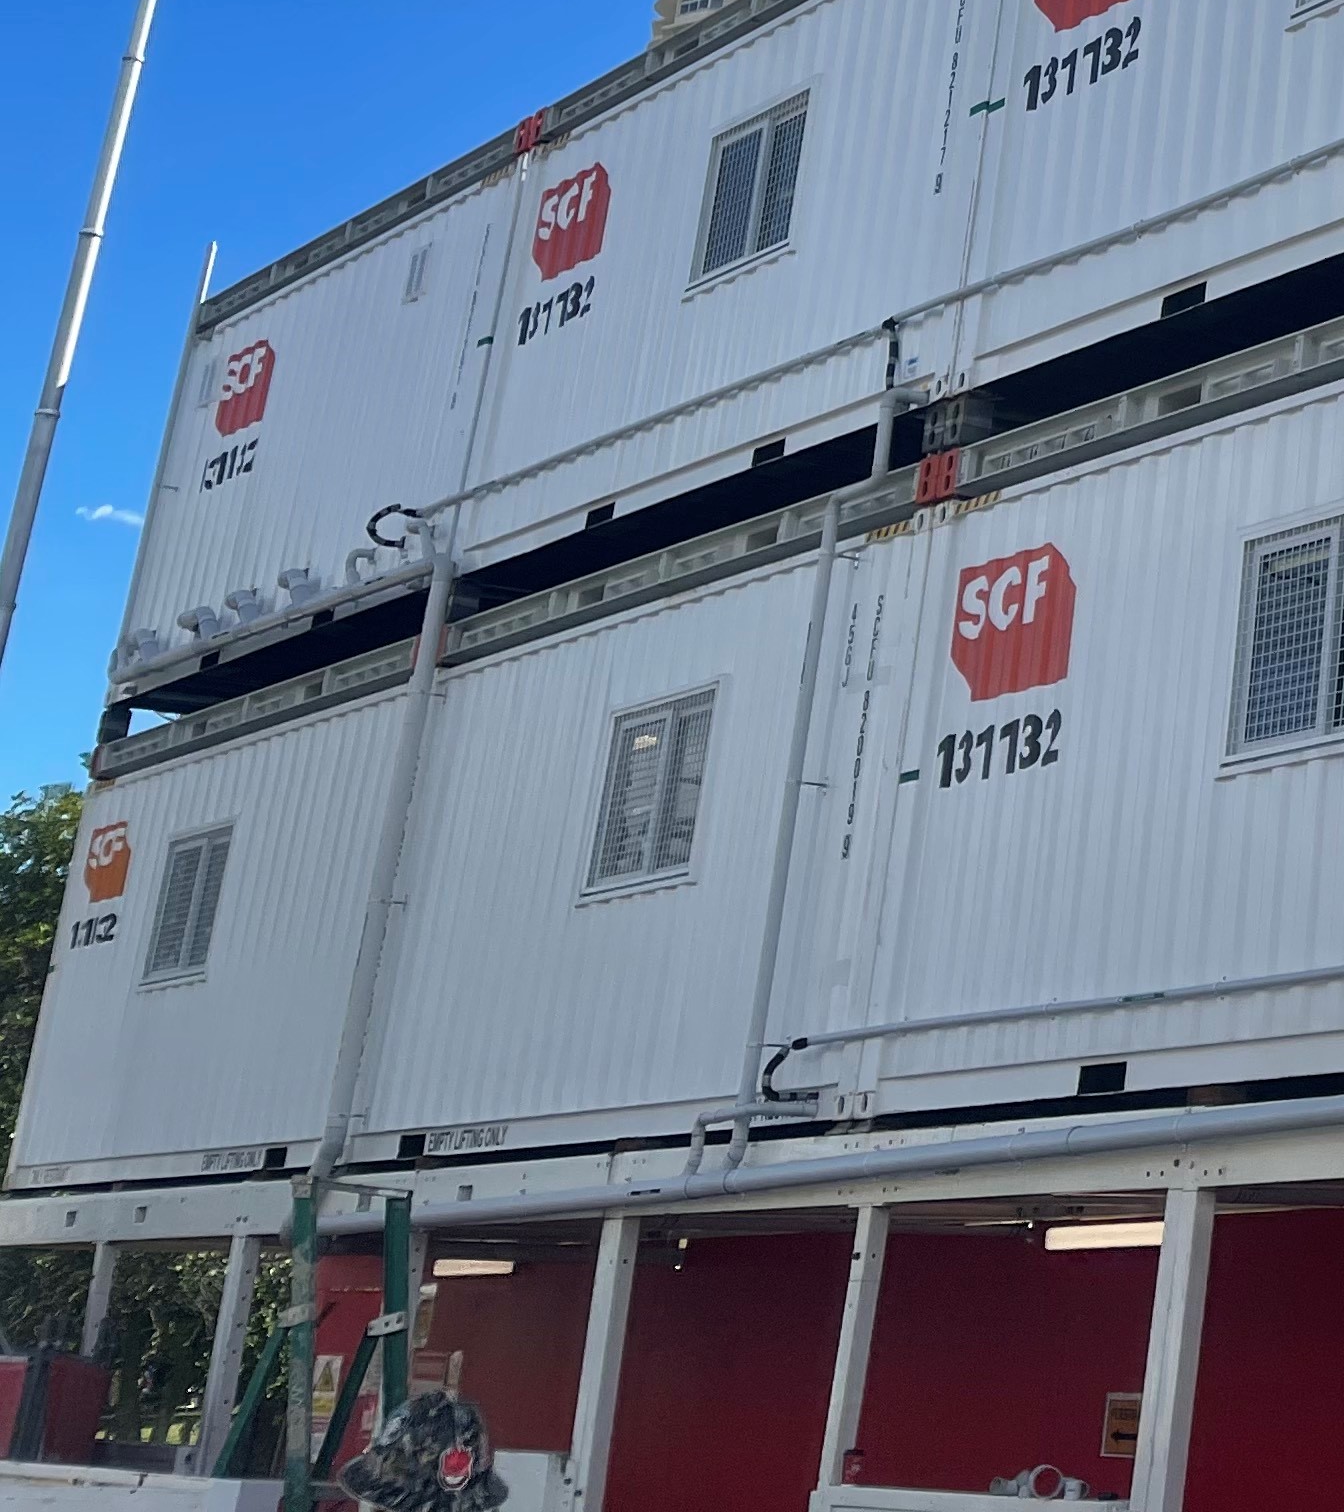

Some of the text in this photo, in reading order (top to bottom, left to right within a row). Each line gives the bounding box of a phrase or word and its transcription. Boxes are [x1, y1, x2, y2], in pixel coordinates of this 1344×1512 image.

[538, 171, 597, 241] SCF
[221, 346, 267, 401] SCF
[958, 555, 1050, 641] SCF
[867, 594, 884, 682] SCFU
[88, 827, 126, 870] SCF
